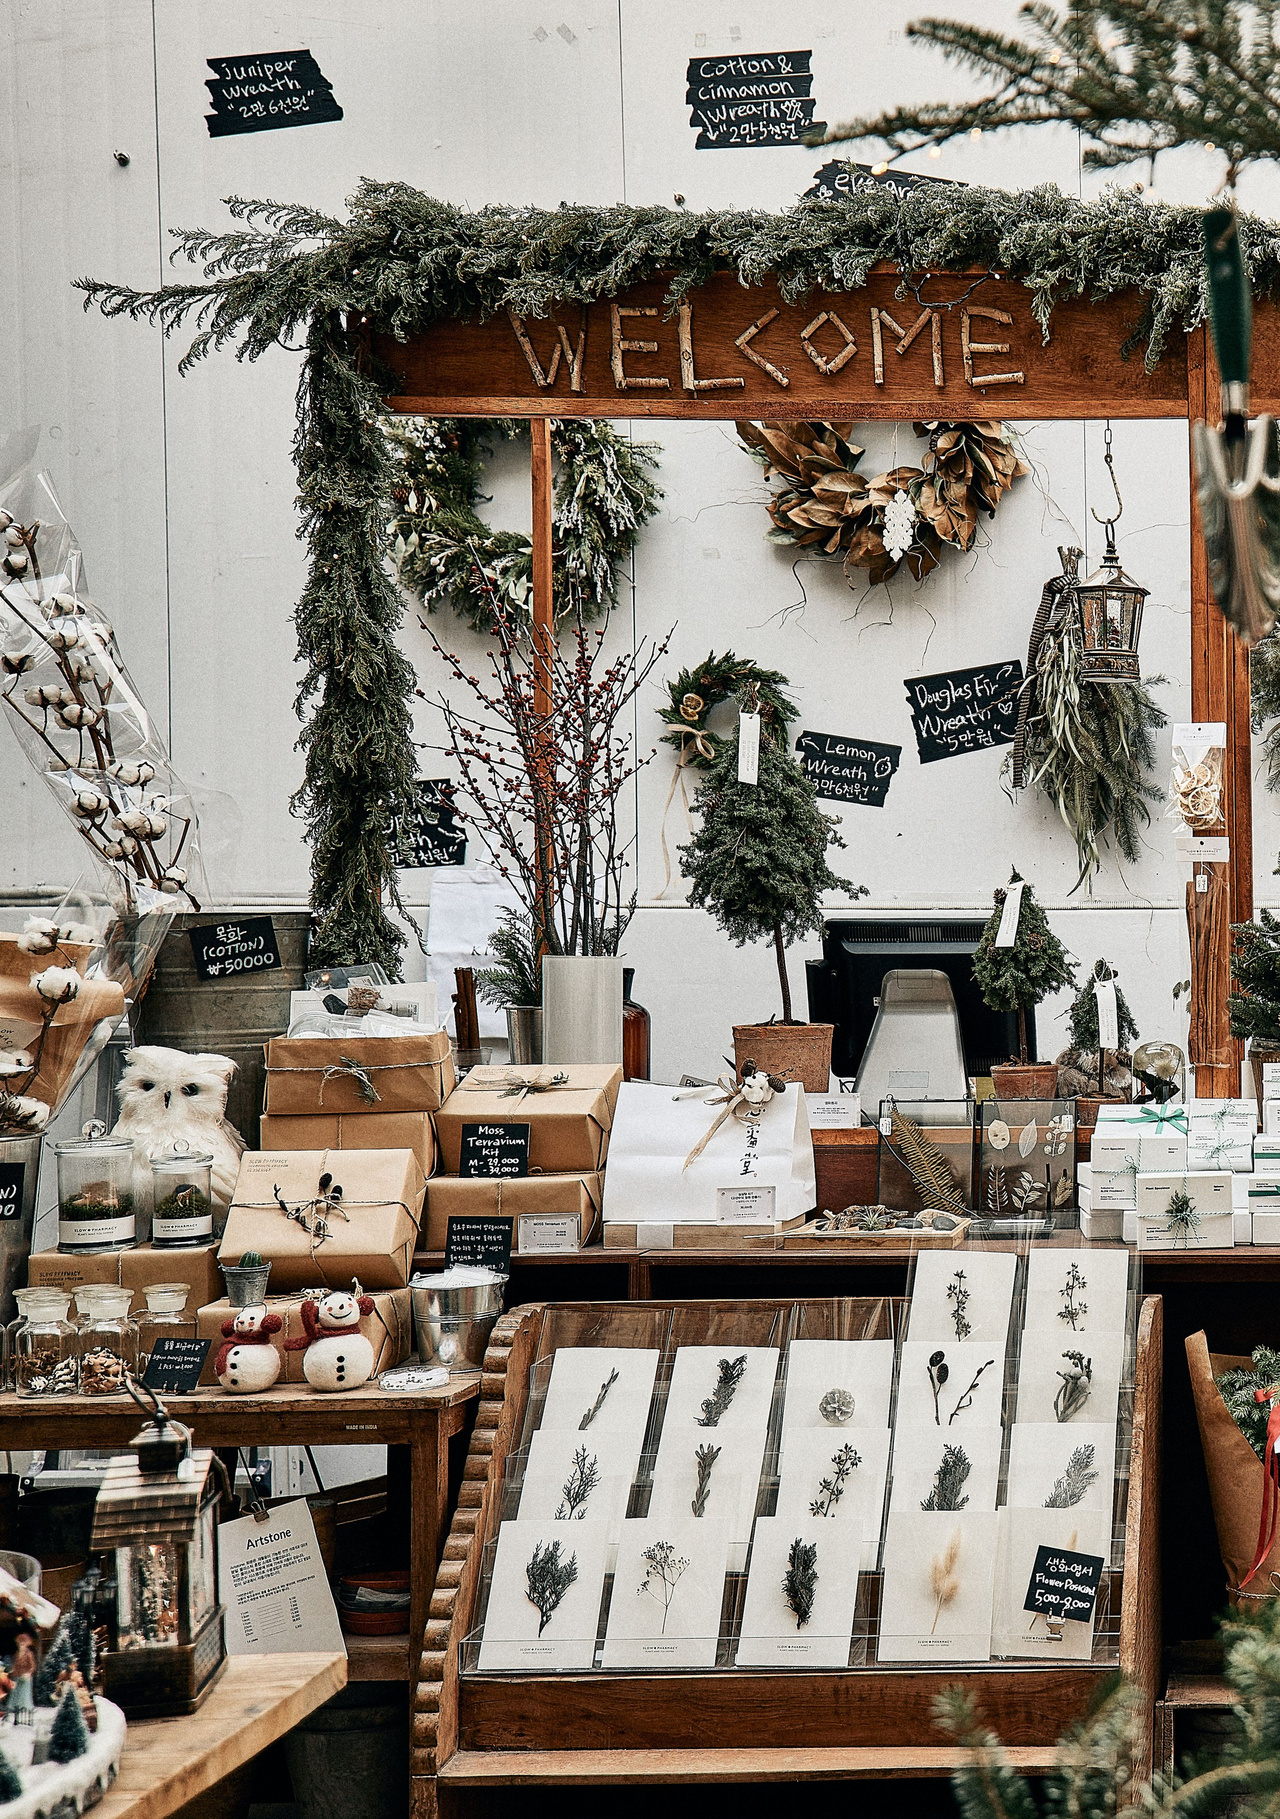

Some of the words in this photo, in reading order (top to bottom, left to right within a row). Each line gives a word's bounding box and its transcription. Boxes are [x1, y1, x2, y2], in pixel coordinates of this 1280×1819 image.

[700, 57, 775, 78] Cotton
[777, 54, 794, 74] &
[507, 299, 1025, 393] WELCOME
[914, 679, 973, 712] Douglas
[973, 674, 999, 697] Fir
[918, 700, 991, 738] Wreath
[825, 737, 876, 762] Lemon
[807, 758, 867, 781] Wreath
[216, 924, 247, 943] 목화
[202, 936, 265, 961] (COTTON)
[206, 952, 275, 976] ₩50000
[478, 1125, 505, 1135] Moss
[482, 1148, 499, 1157] Kit
[487, 1158, 520, 1167] 29,000
[489, 1166, 519, 1175] 39,000
[246, 1528, 292, 1550] Artstone
[1035, 1573, 1064, 1588] Flower
